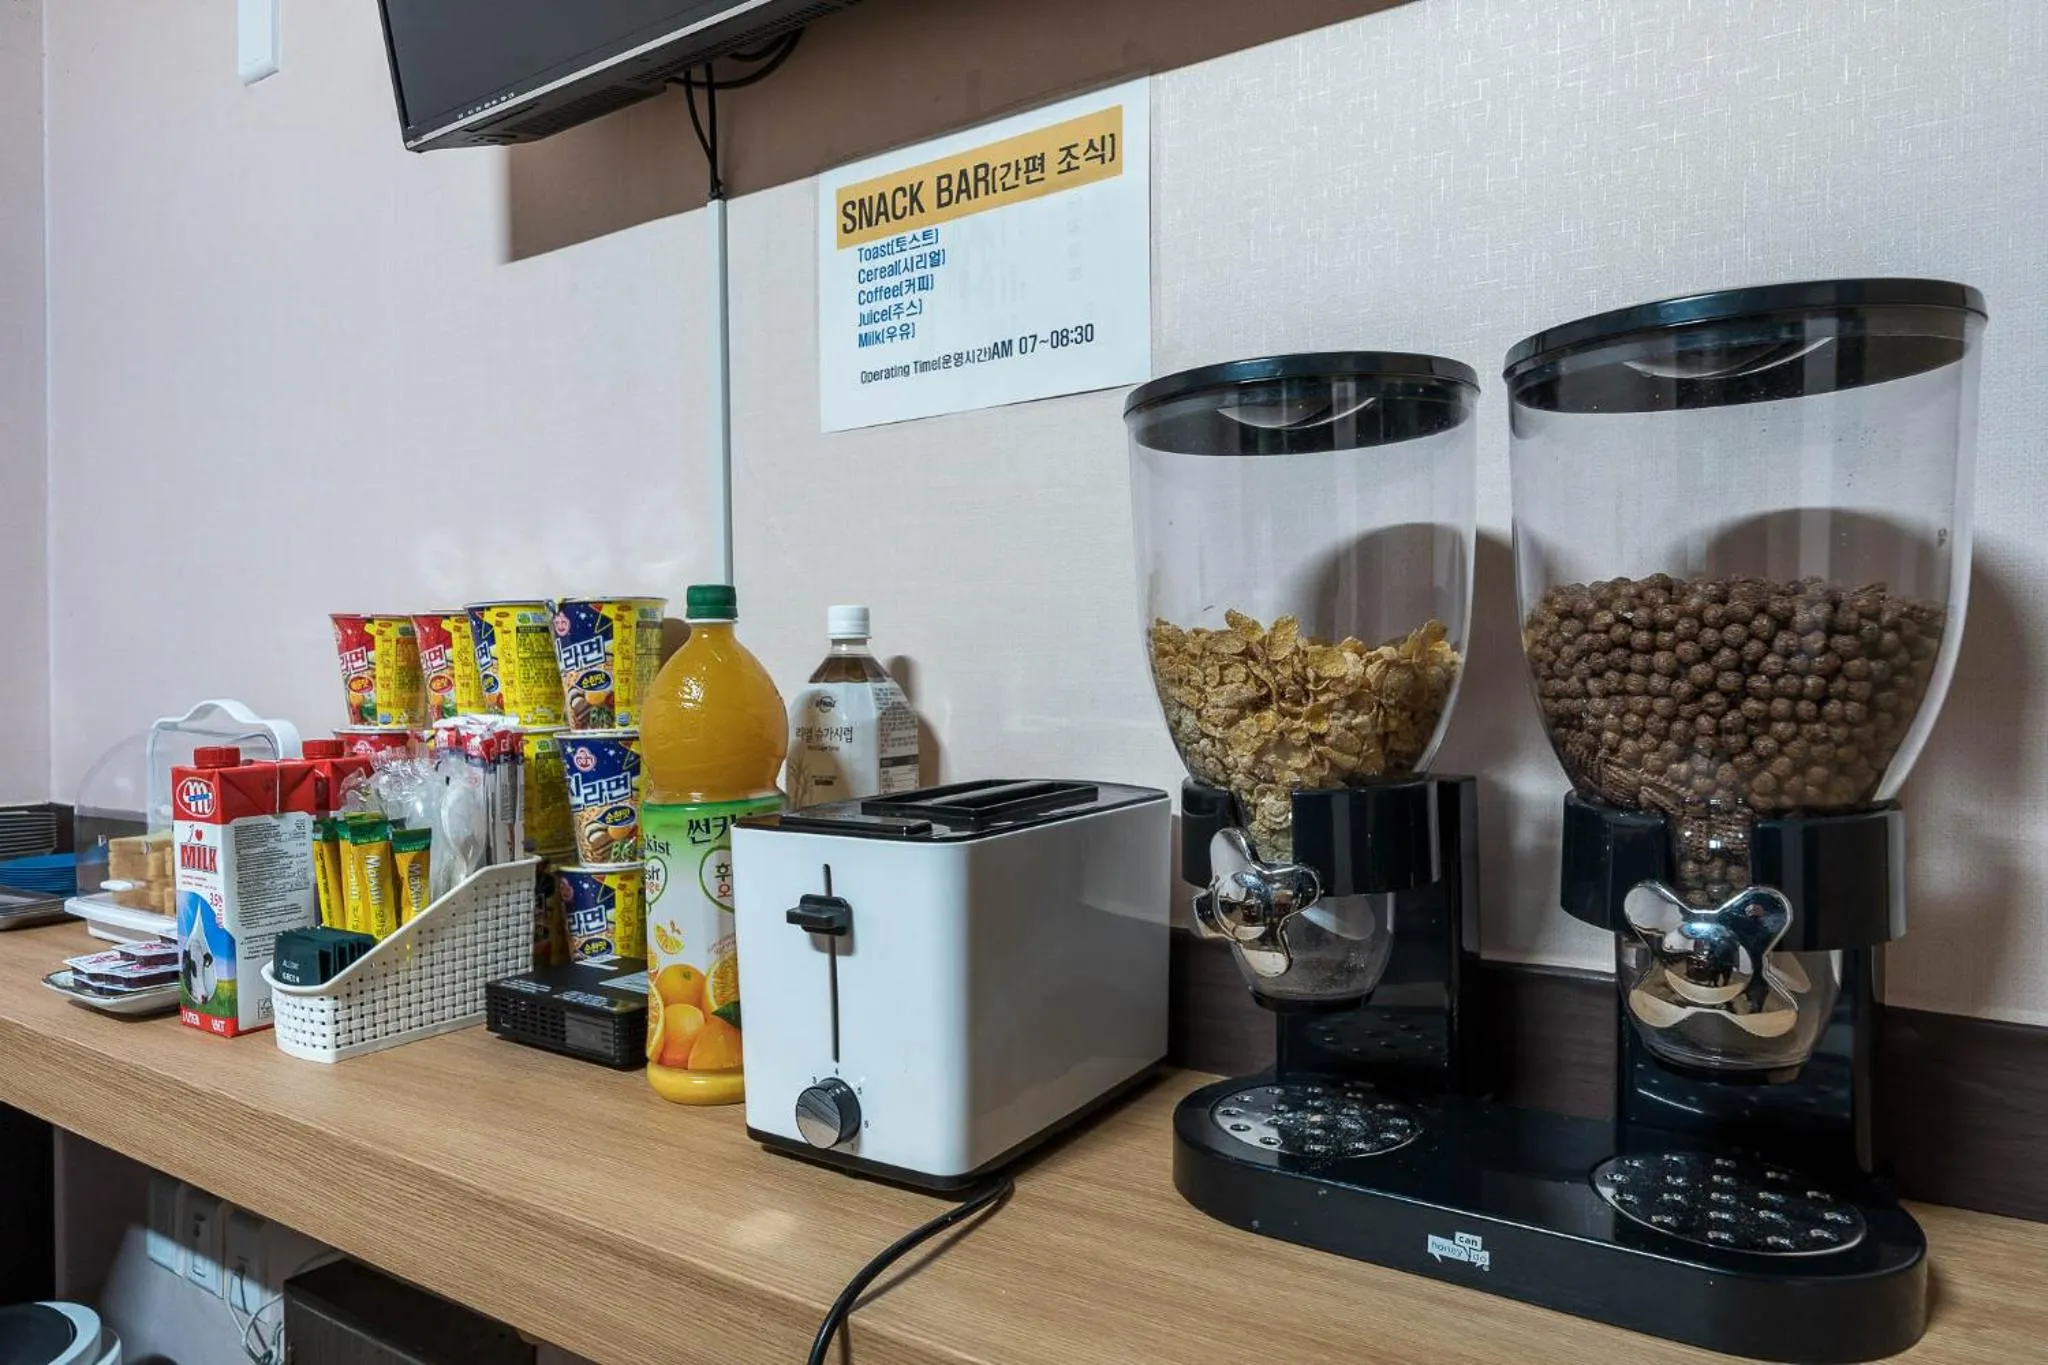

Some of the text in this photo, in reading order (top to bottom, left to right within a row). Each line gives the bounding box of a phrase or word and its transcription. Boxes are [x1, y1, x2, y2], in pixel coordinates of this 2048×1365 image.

[842, 180, 925, 234] SNACK
[860, 364, 910, 384] Operating
[1019, 322, 1094, 355] 07~08:30
[687, 814, 736, 845] 썬키
[180, 843, 218, 874] MILK
[645, 835, 672, 858] kist
[1431, 1240, 1464, 1258] honey
[1459, 1235, 1479, 1247] can
